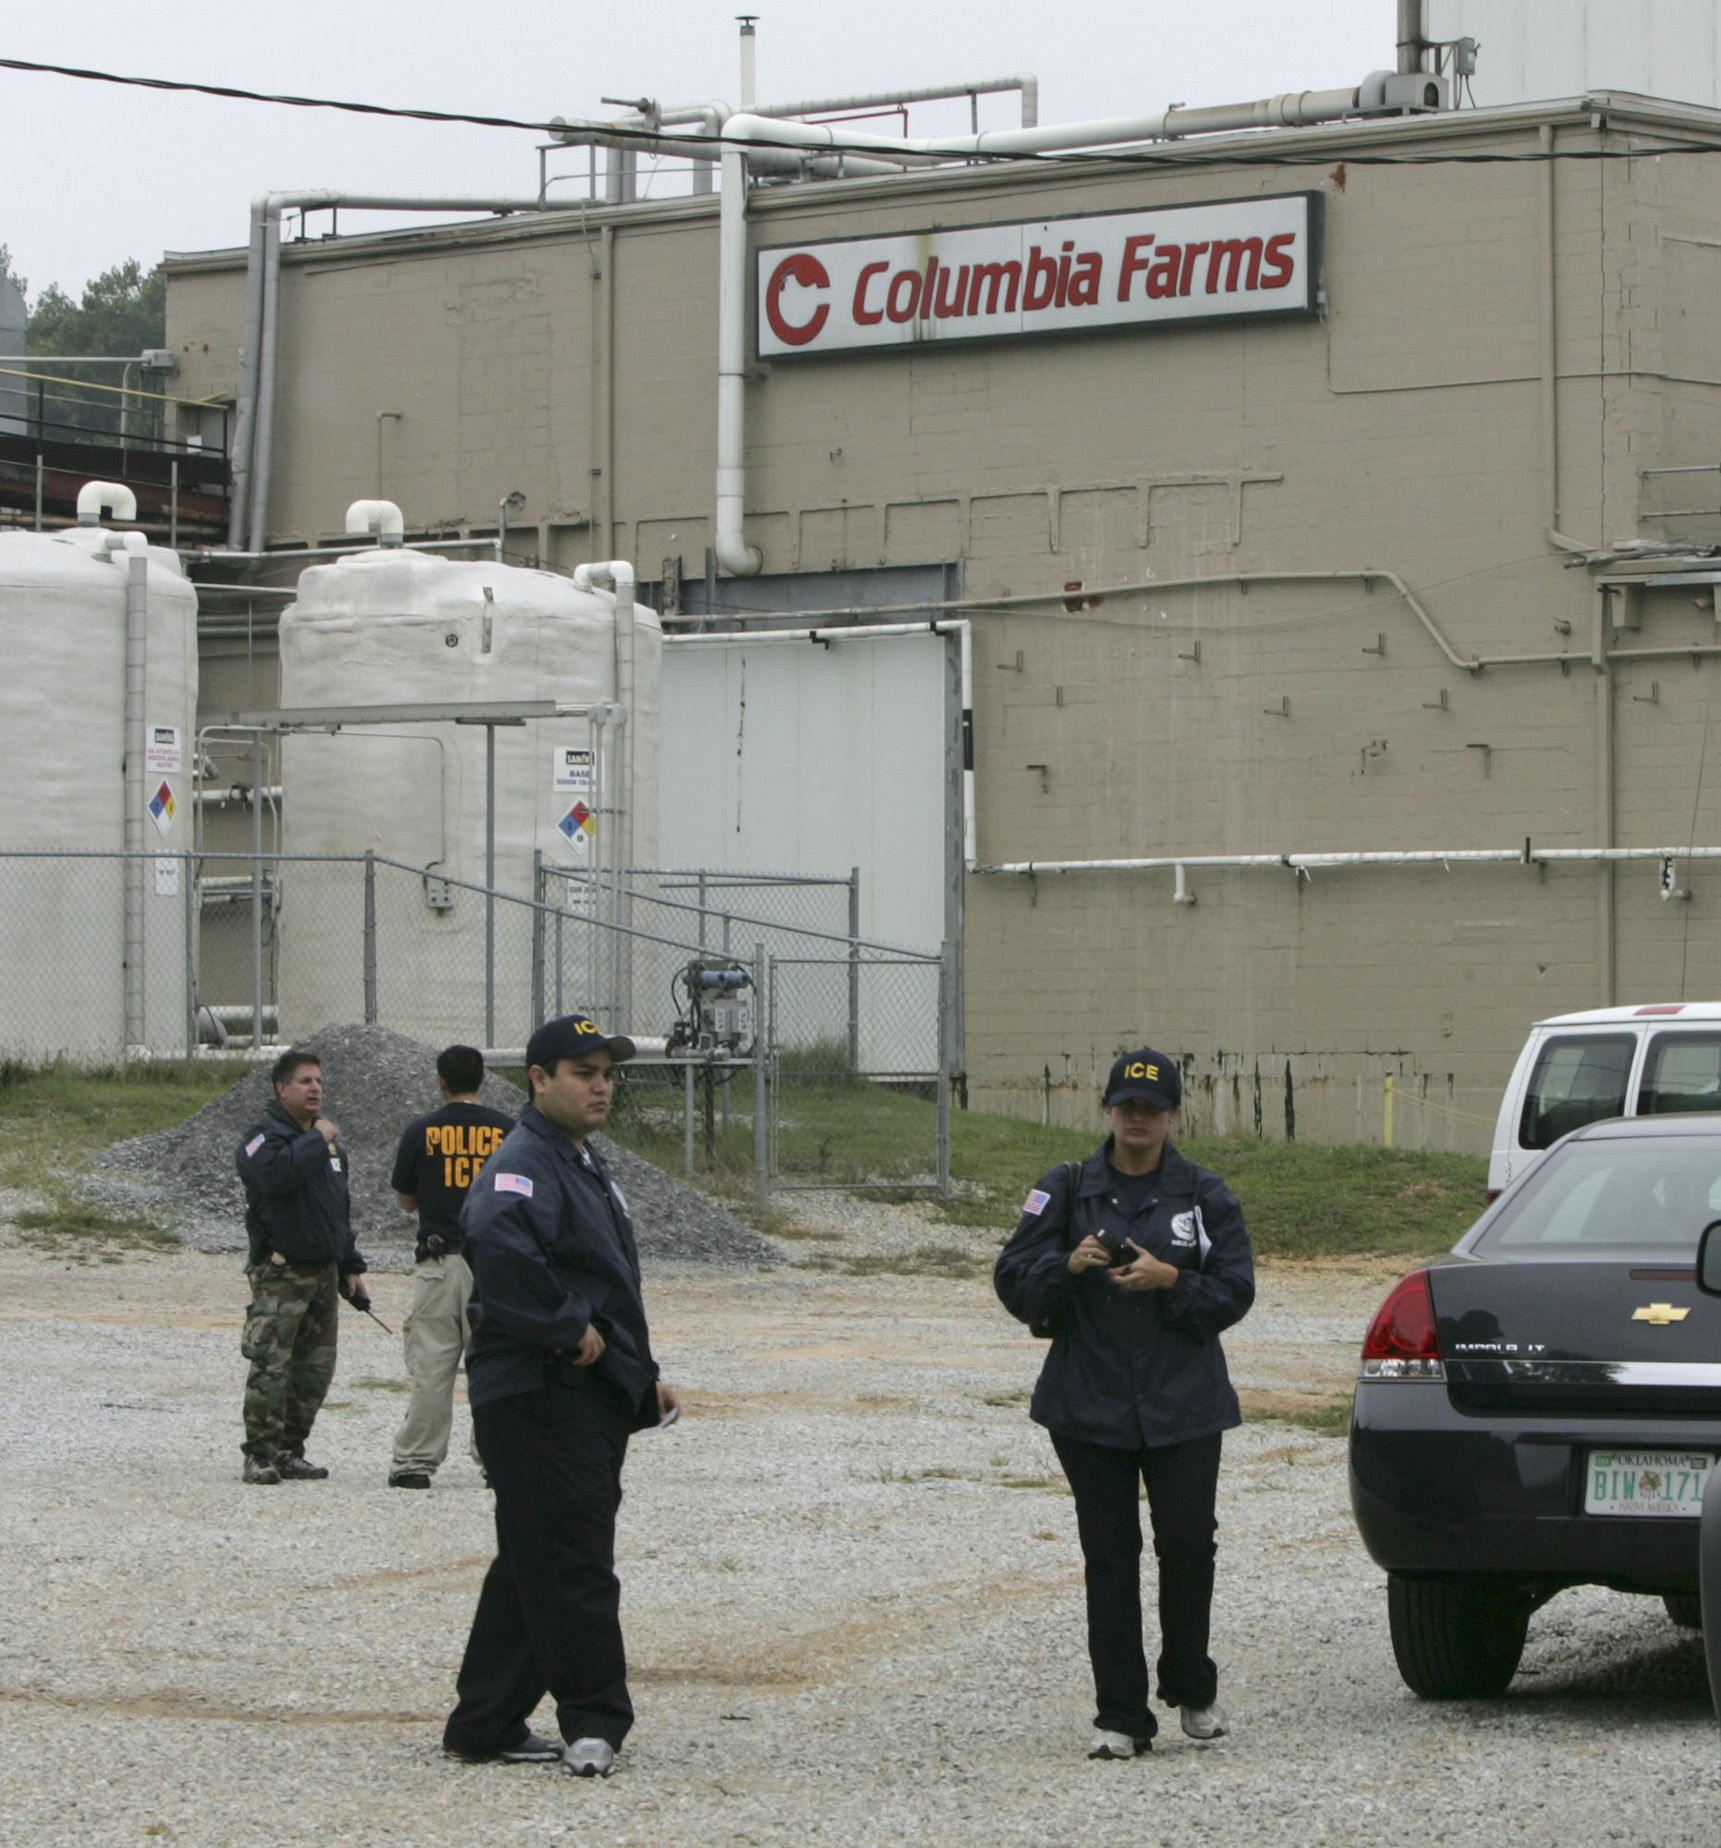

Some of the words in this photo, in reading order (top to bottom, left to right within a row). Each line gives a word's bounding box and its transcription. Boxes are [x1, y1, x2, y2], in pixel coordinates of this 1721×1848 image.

[852, 240, 1103, 326] Columbia
[1116, 232, 1297, 302] Farms
[573, 1019, 600, 1036] IC
[1124, 1062, 1160, 1081] ICE
[425, 1125, 504, 1157] POLICE
[1617, 1454, 1685, 1467] OKLAHOMA
[1593, 1470, 1636, 1501] BIW
[1661, 1470, 1704, 1502] 171
